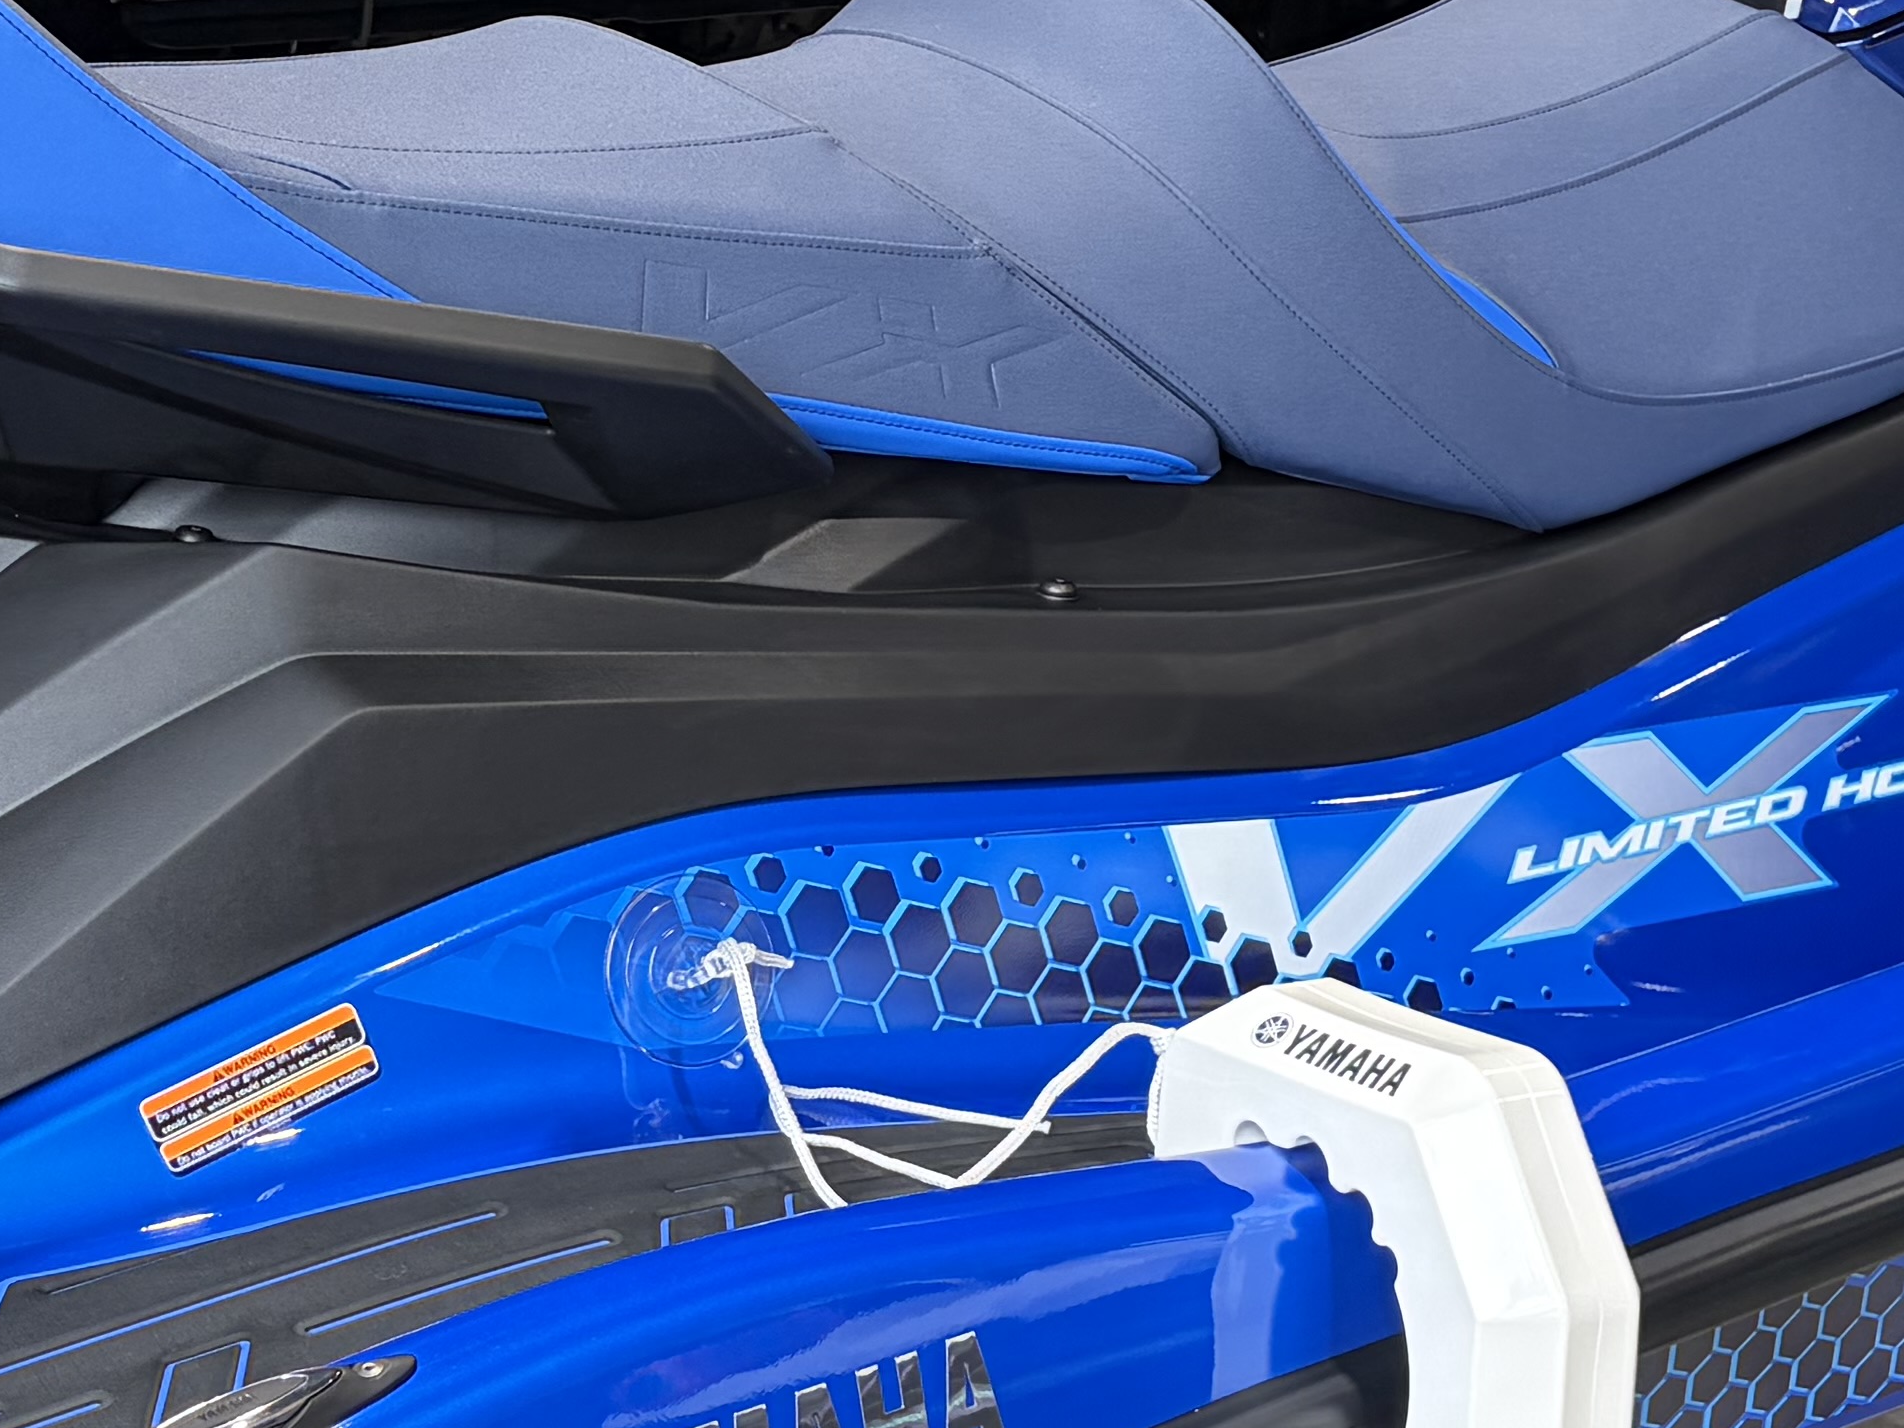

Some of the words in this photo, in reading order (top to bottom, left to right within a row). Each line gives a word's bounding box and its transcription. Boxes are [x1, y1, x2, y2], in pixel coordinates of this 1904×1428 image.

[1164, 690, 1898, 978] VX
[1507, 785, 1808, 884] LIMITED
[155, 1110, 170, 1124] Do
[170, 1101, 188, 1116] not
[265, 1058, 277, 1071] to
[160, 1115, 188, 1134] could
[206, 1092, 234, 1113] which
[234, 1080, 261, 1100] could
[260, 1067, 289, 1087] result
[288, 1062, 298, 1074] in
[298, 1048, 329, 1069] severe
[328, 1034, 357, 1056] injury.
[223, 1044, 277, 1076] WARNING
[1283, 1025, 1413, 1099] YAMAHA
[241, 1086, 296, 1117] WARNING
